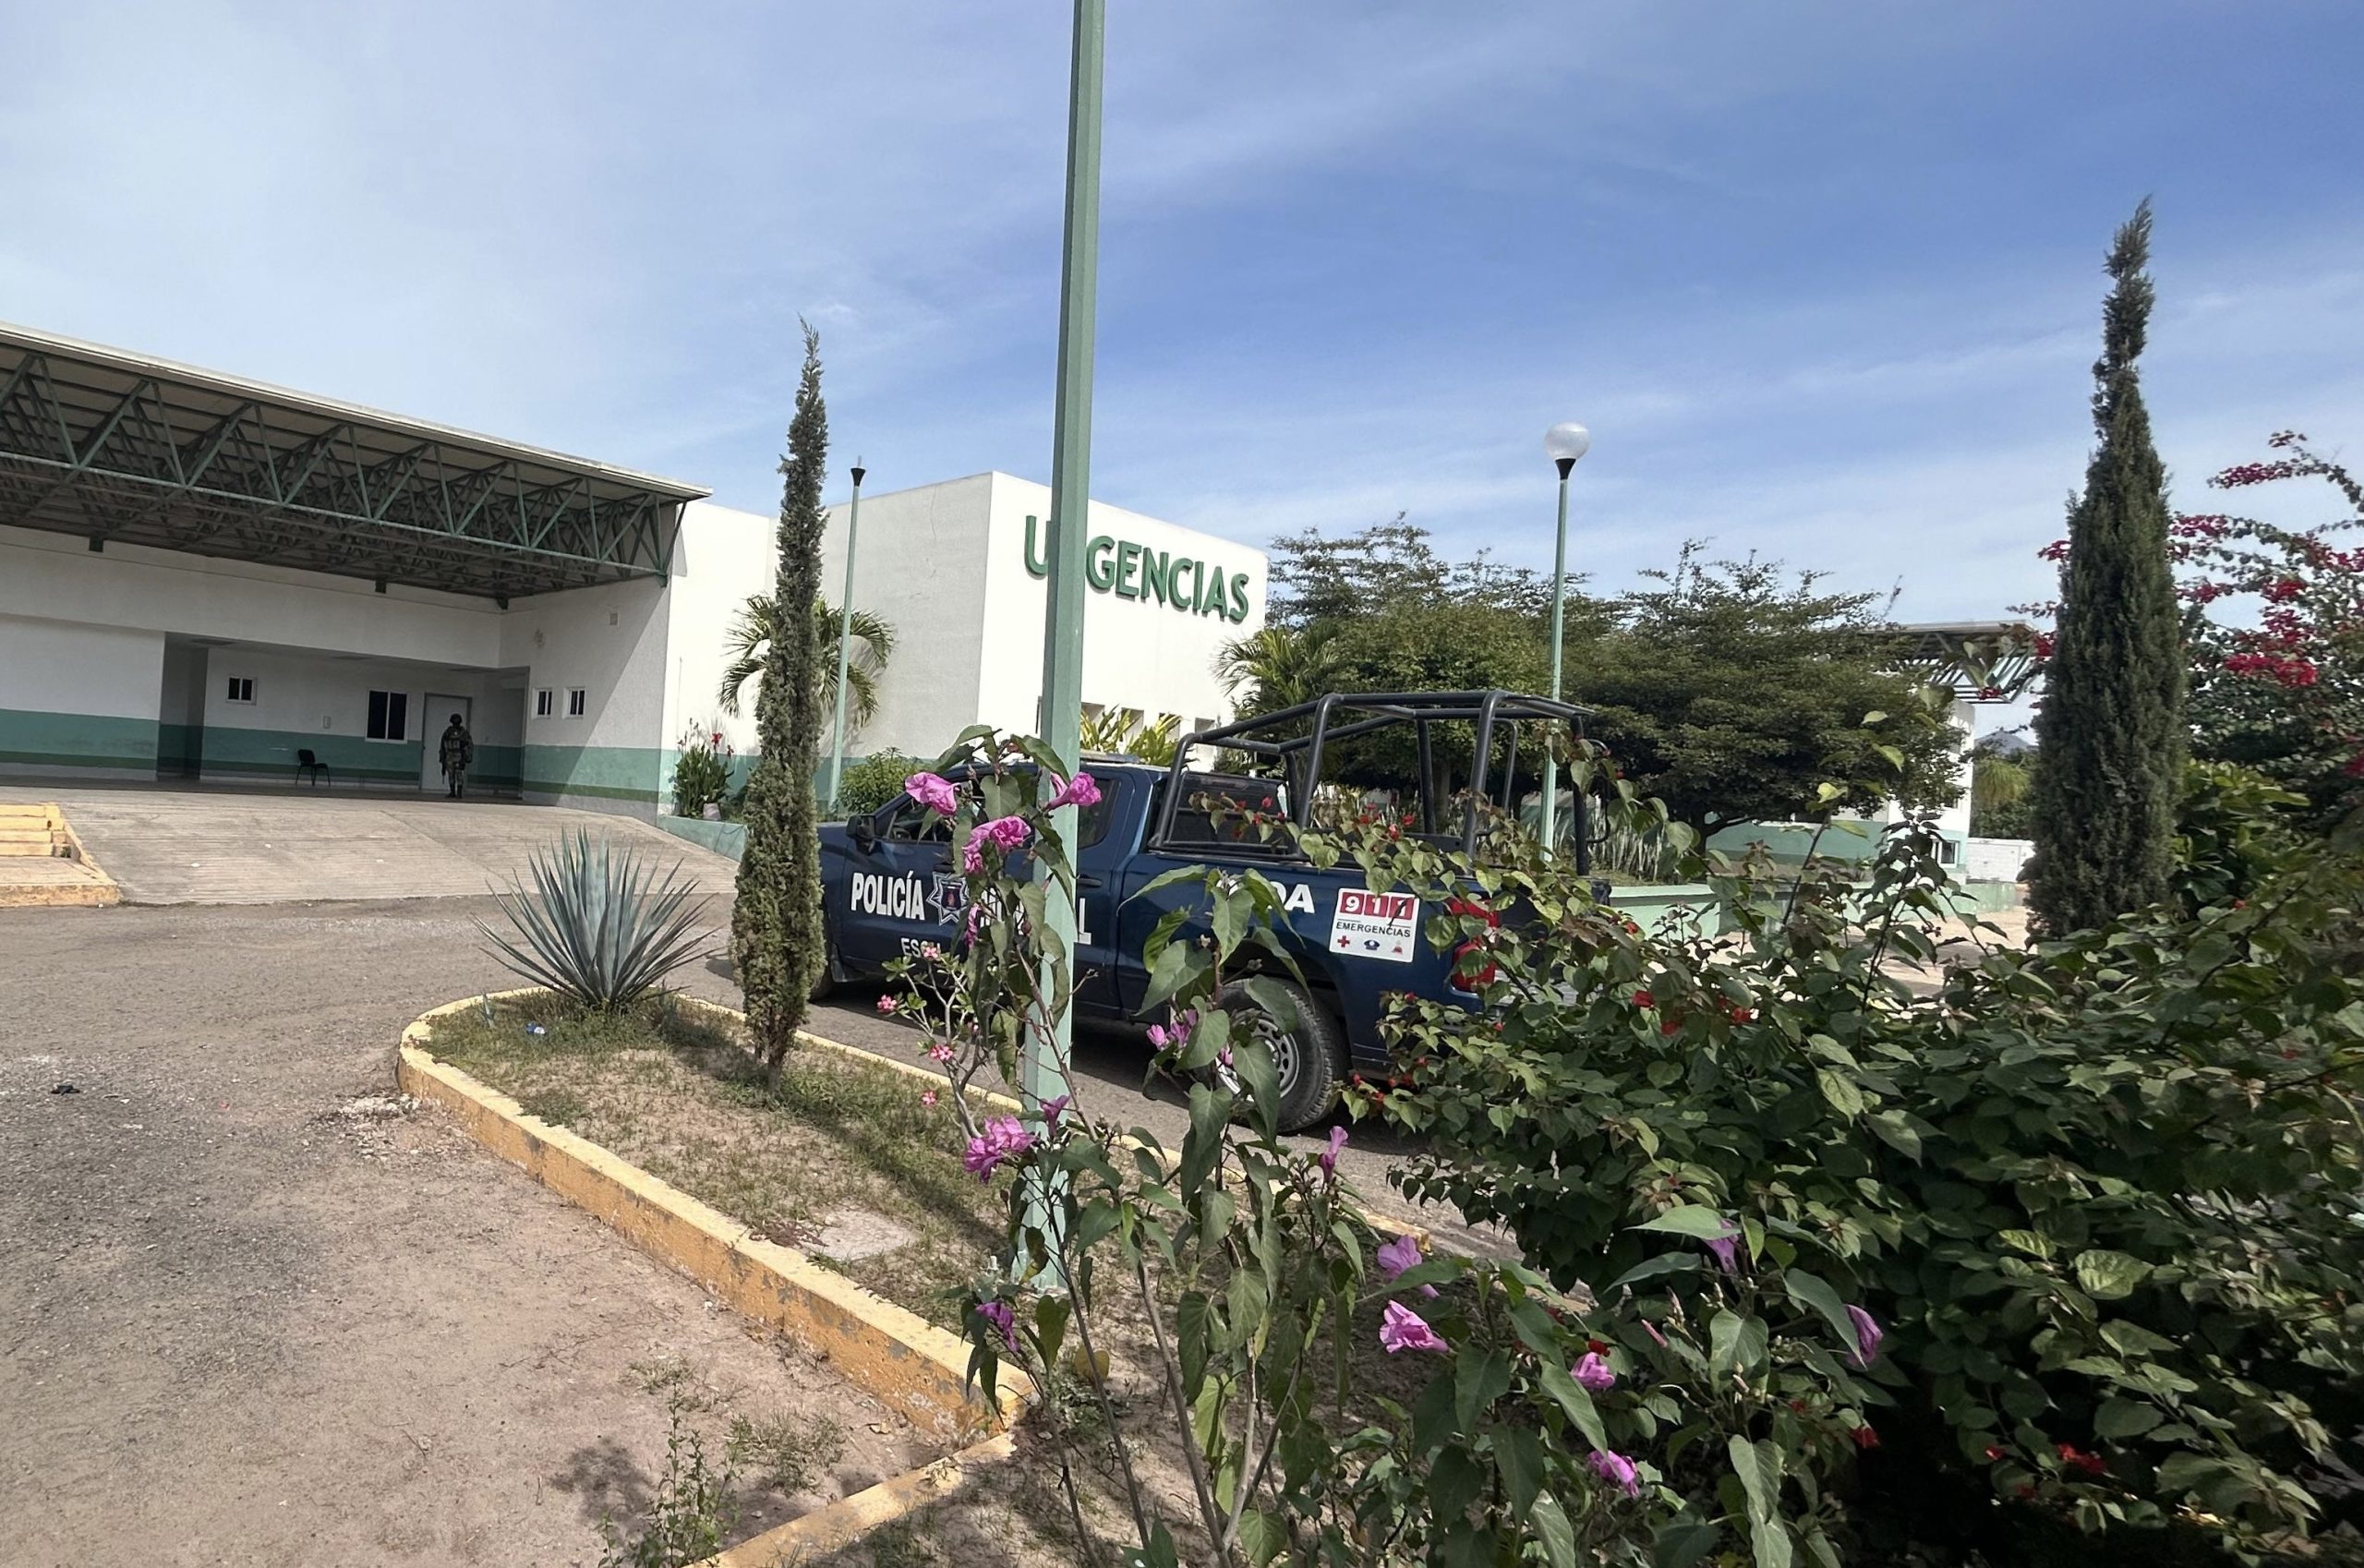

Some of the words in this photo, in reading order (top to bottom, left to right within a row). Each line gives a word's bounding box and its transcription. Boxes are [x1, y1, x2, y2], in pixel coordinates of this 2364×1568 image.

[1024, 515, 1249, 621] UGENCIAS
[850, 870, 925, 921] POLICÍA
[1345, 896, 1406, 918] 911
[1335, 921, 1411, 937] EMERGENCIAS
